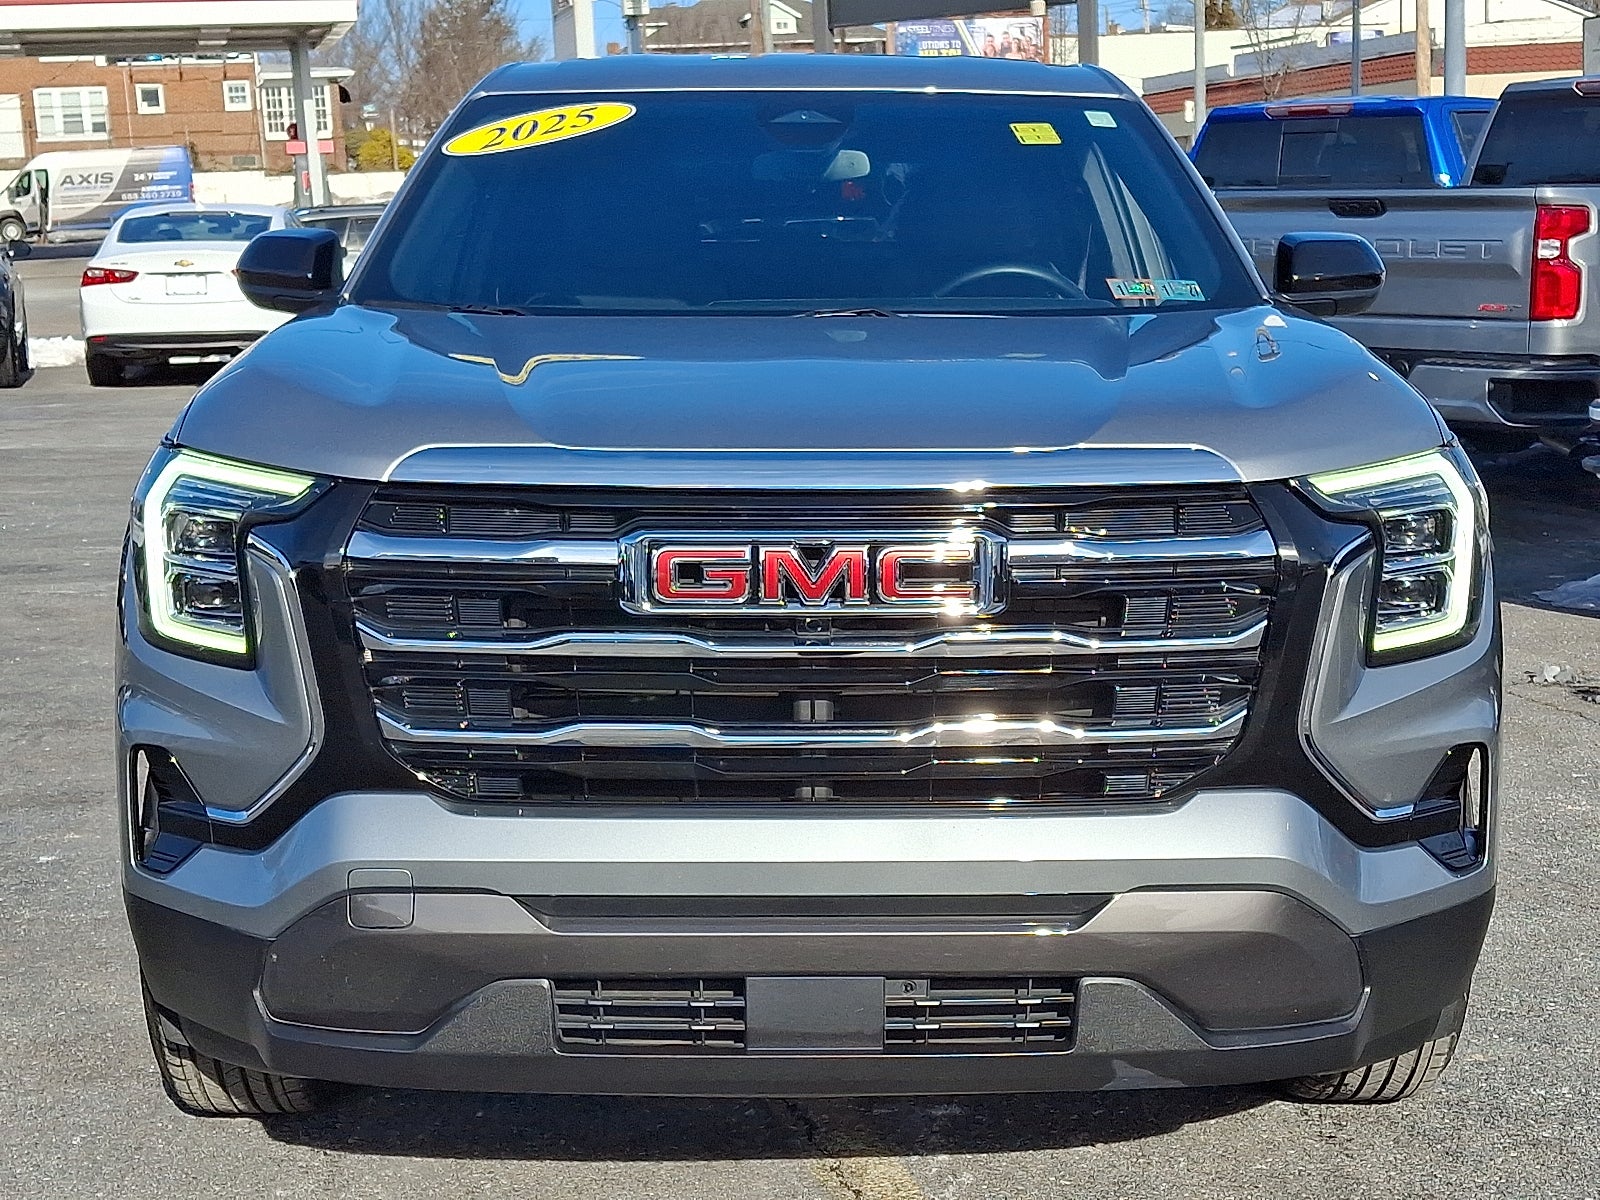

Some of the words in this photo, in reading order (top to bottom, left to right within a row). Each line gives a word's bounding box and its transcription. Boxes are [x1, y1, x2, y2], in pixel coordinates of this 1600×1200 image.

[480, 106, 598, 151] 2025
[60, 172, 114, 186] AXIS
[653, 544, 976, 606] GMC
